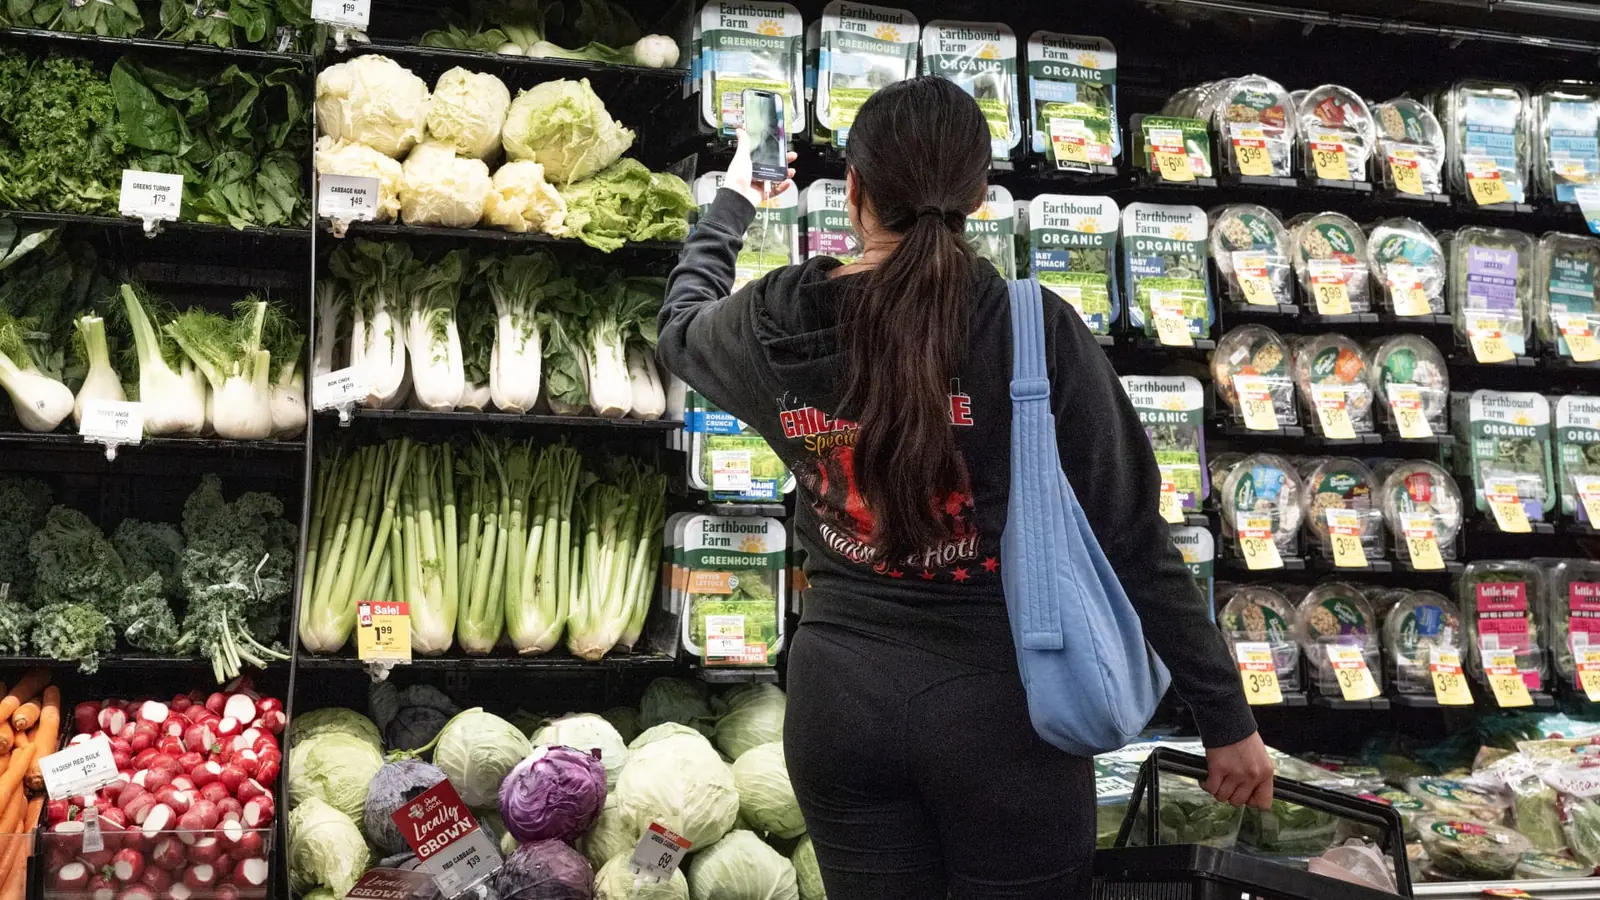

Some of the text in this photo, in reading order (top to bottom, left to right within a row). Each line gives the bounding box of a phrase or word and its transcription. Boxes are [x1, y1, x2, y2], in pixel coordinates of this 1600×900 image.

[720, 2, 785, 18] Earthbound
[840, 4, 903, 25] Earthbound
[720, 15, 748, 28] Farm
[839, 17, 867, 32] Farm
[940, 27, 1000, 41] Earthbound
[720, 36, 785, 49] GREENHOUSE
[838, 38, 901, 55] GREENHOUSE
[940, 40, 966, 52] Farm
[1042, 36, 1101, 51] Earthbound
[1043, 47, 1069, 60] Farm
[940, 60, 1001, 71] ORGANIC
[1043, 65, 1101, 80] ORGANIC
[331, 186, 353, 194] CABBAGE
[1043, 202, 1103, 215] Earthbound
[1043, 214, 1069, 227] Farm
[1135, 210, 1192, 224] Earthbound
[1136, 222, 1161, 234] Farm
[820, 233, 843, 241] SPRING
[1042, 234, 1103, 246] ORGANIC
[1136, 240, 1194, 252] ORGANIC
[1128, 381, 1186, 392] Earthbound
[1129, 393, 1154, 405] Farm
[1482, 395, 1533, 409] Earthbound
[1139, 412, 1188, 423] RGANIC
[1483, 408, 1505, 419] Farm
[1569, 414, 1590, 424] Farm
[1483, 424, 1536, 437] ORGANIC
[740, 489, 772, 497] CRUNCH
[702, 519, 768, 534] Earthbound
[702, 534, 731, 547] Farm
[925, 536, 977, 567] Hot!
[701, 556, 768, 566] GREENHOUSE
[374, 605, 400, 615] Sale!
[73, 757, 85, 766] RED
[413, 805, 459, 841] Locally
[417, 816, 473, 857] GROWN
[442, 846, 477, 871] RED CABBAGE
[364, 876, 413, 891] Locally
[351, 888, 409, 899] GROWN
